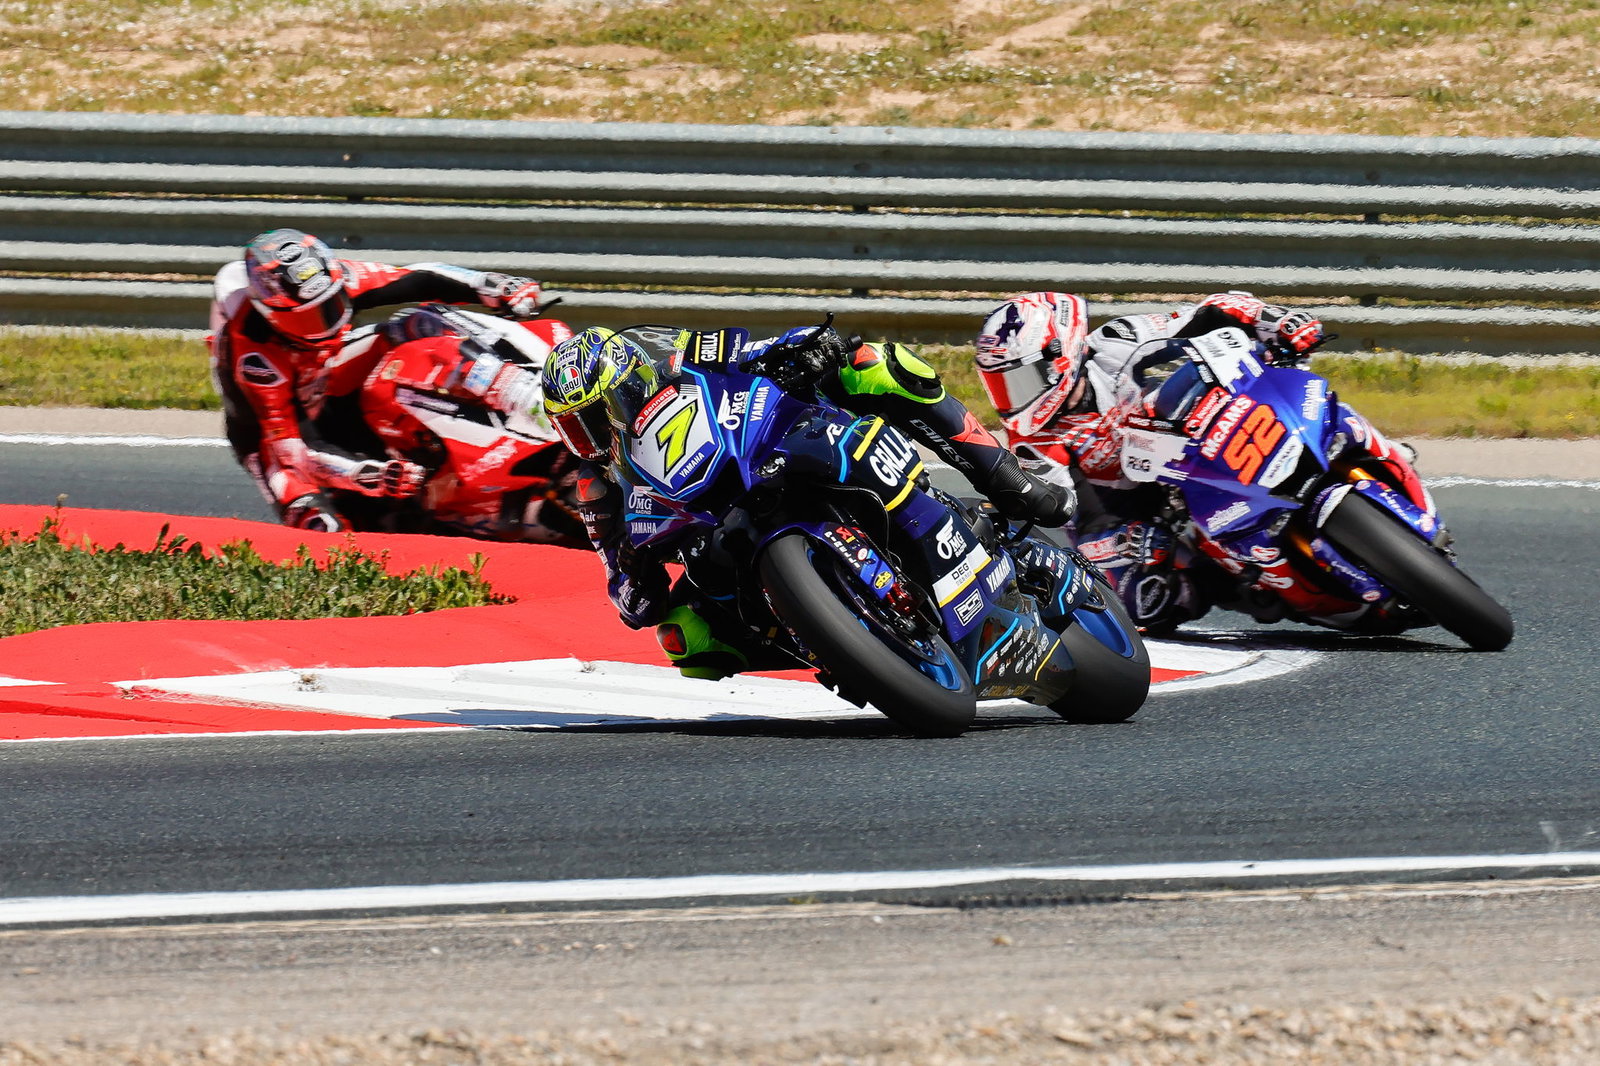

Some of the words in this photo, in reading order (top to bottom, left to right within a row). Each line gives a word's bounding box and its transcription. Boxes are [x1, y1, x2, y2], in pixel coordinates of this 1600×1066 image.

[700, 332, 718, 361] GRILLA
[564, 378, 579, 393] agv
[643, 387, 675, 416] Bennetts
[722, 391, 746, 430] OMG
[750, 386, 770, 421] YAMAHA
[655, 399, 698, 479] 7
[908, 418, 975, 471] DAINESE
[1222, 404, 1287, 487] 52
[679, 452, 705, 478] YAMAHA
[628, 491, 652, 511] OMG
[631, 522, 657, 534] YAMAHA
[824, 531, 860, 569] PIRELLI
[937, 531, 965, 560] OMG
[951, 562, 970, 580] DEG
[986, 555, 1012, 593] YAMAHA
